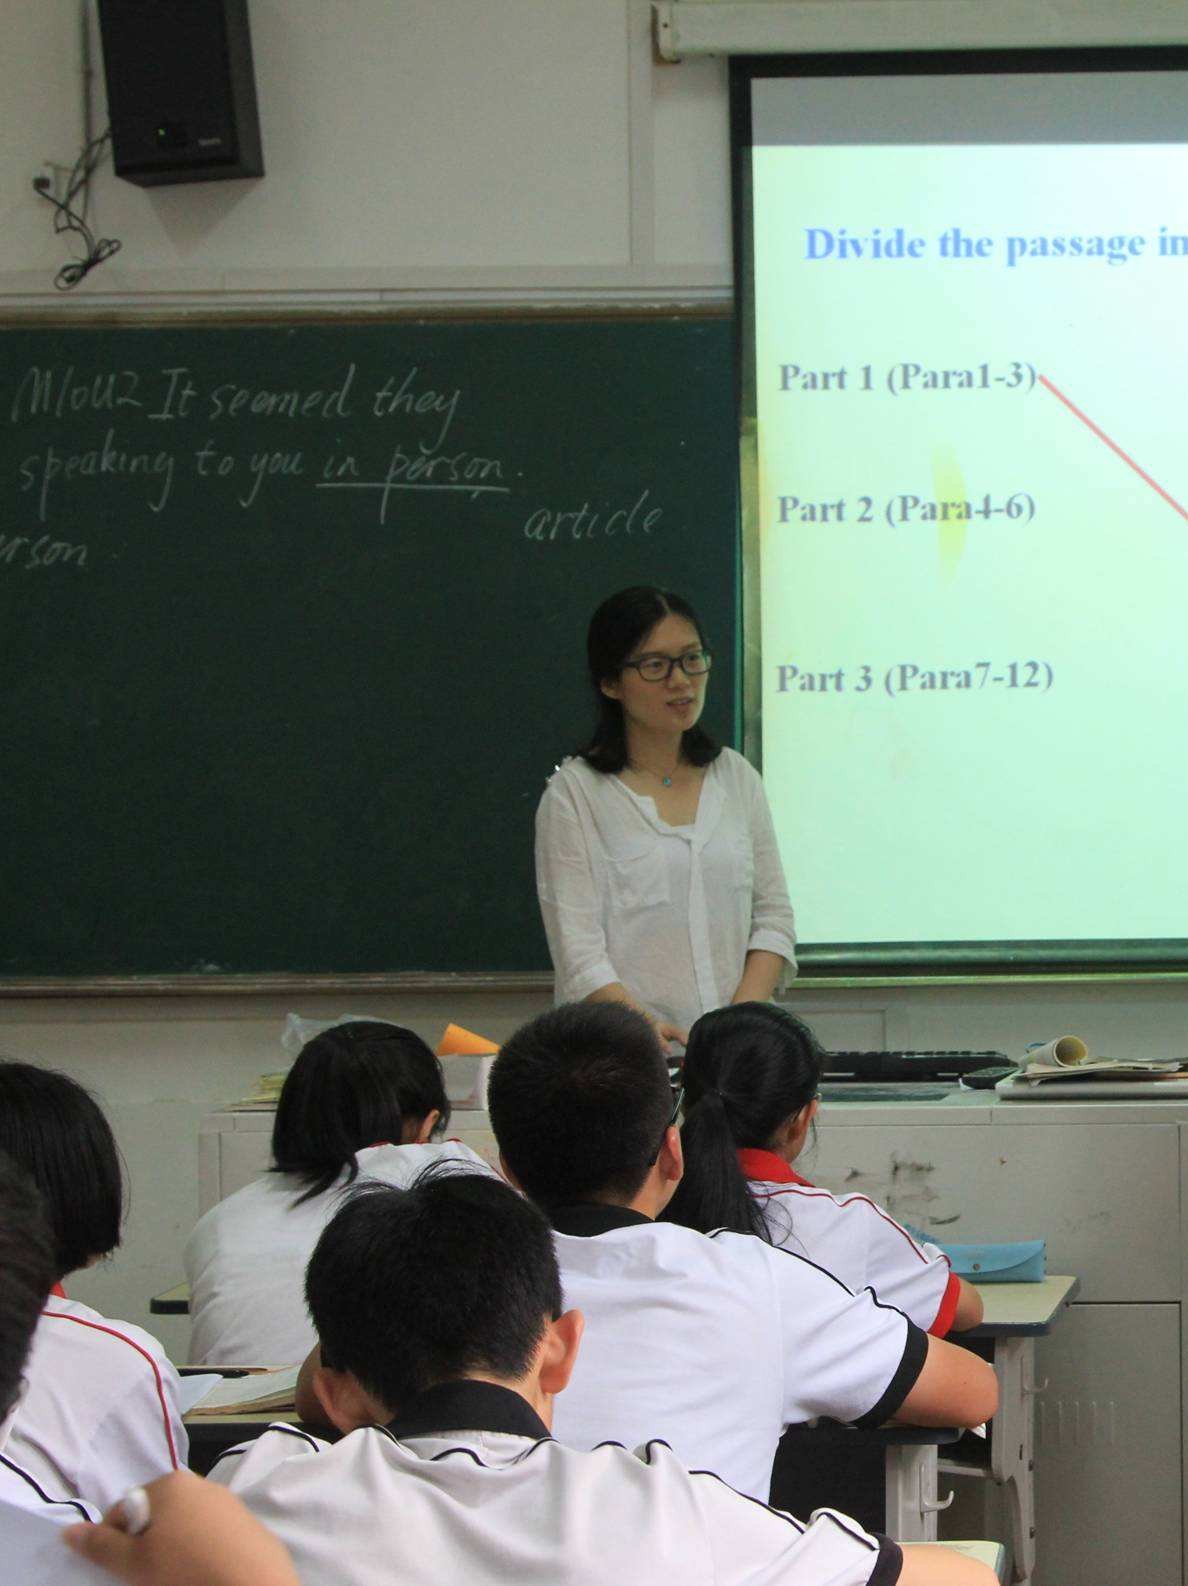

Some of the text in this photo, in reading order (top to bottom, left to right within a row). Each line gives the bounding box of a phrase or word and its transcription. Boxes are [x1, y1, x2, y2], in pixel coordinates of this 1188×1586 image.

[803, 226, 926, 261] Divide
[938, 226, 994, 259] the
[1005, 232, 1146, 267] passage
[779, 361, 1038, 393] Part 1 (Para1-3)
[147, 366, 199, 420] It
[373, 366, 461, 454] they
[19, 428, 175, 522] speaking
[195, 438, 234, 477] to
[240, 450, 304, 508] you
[323, 438, 360, 480] in
[523, 489, 664, 541] article
[778, 493, 1037, 526] Part 2 (Para4-6)
[776, 661, 1055, 697] Part 3 (Para7-12)
